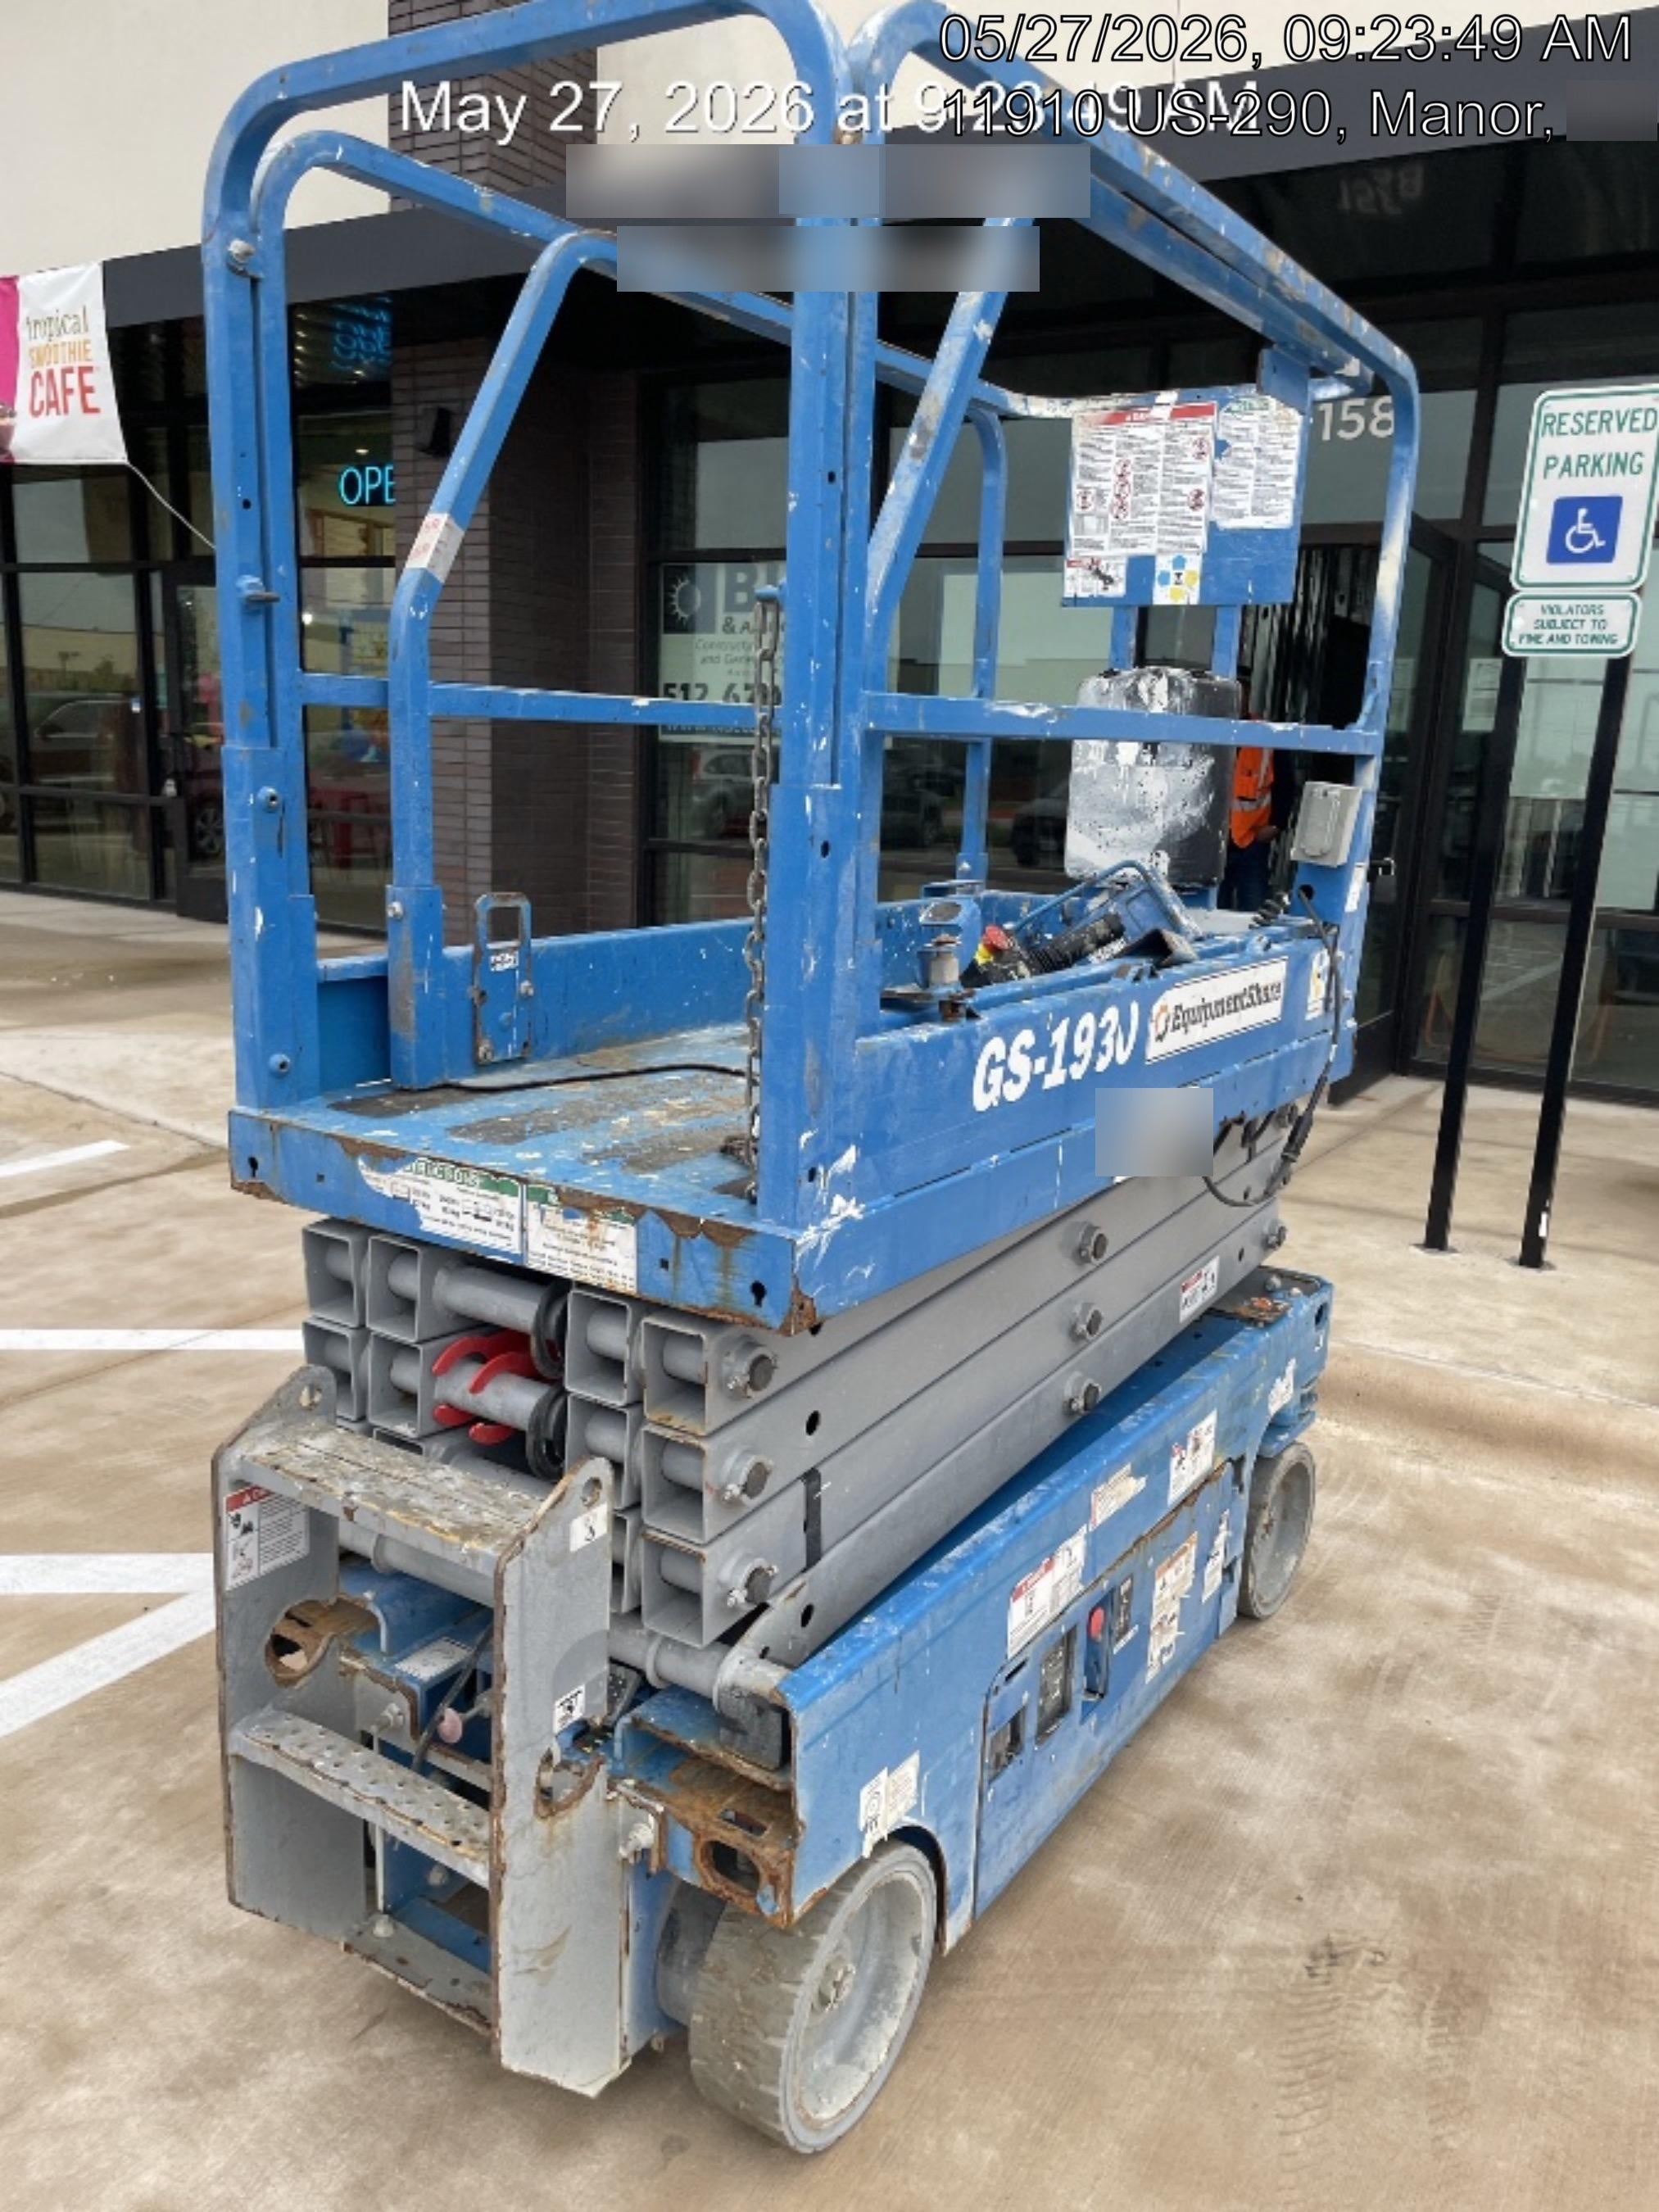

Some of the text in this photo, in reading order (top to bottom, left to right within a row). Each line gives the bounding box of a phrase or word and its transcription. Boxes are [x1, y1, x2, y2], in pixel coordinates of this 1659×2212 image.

[26, 306, 88, 342] tropical
[29, 338, 92, 369] SMOOTHIE
[29, 365, 101, 418] CAFE
[1317, 395, 1394, 441] 158
[1541, 407, 1657, 437] RESERVED
[1543, 451, 1644, 479] PARKING
[1534, 619, 1608, 630] SUBJECT TO
[1541, 605, 1604, 615] VIOLATORS
[1519, 633, 1619, 645] FINE AND TOWING
[1172, 982, 1281, 1034] EquipmentShare
